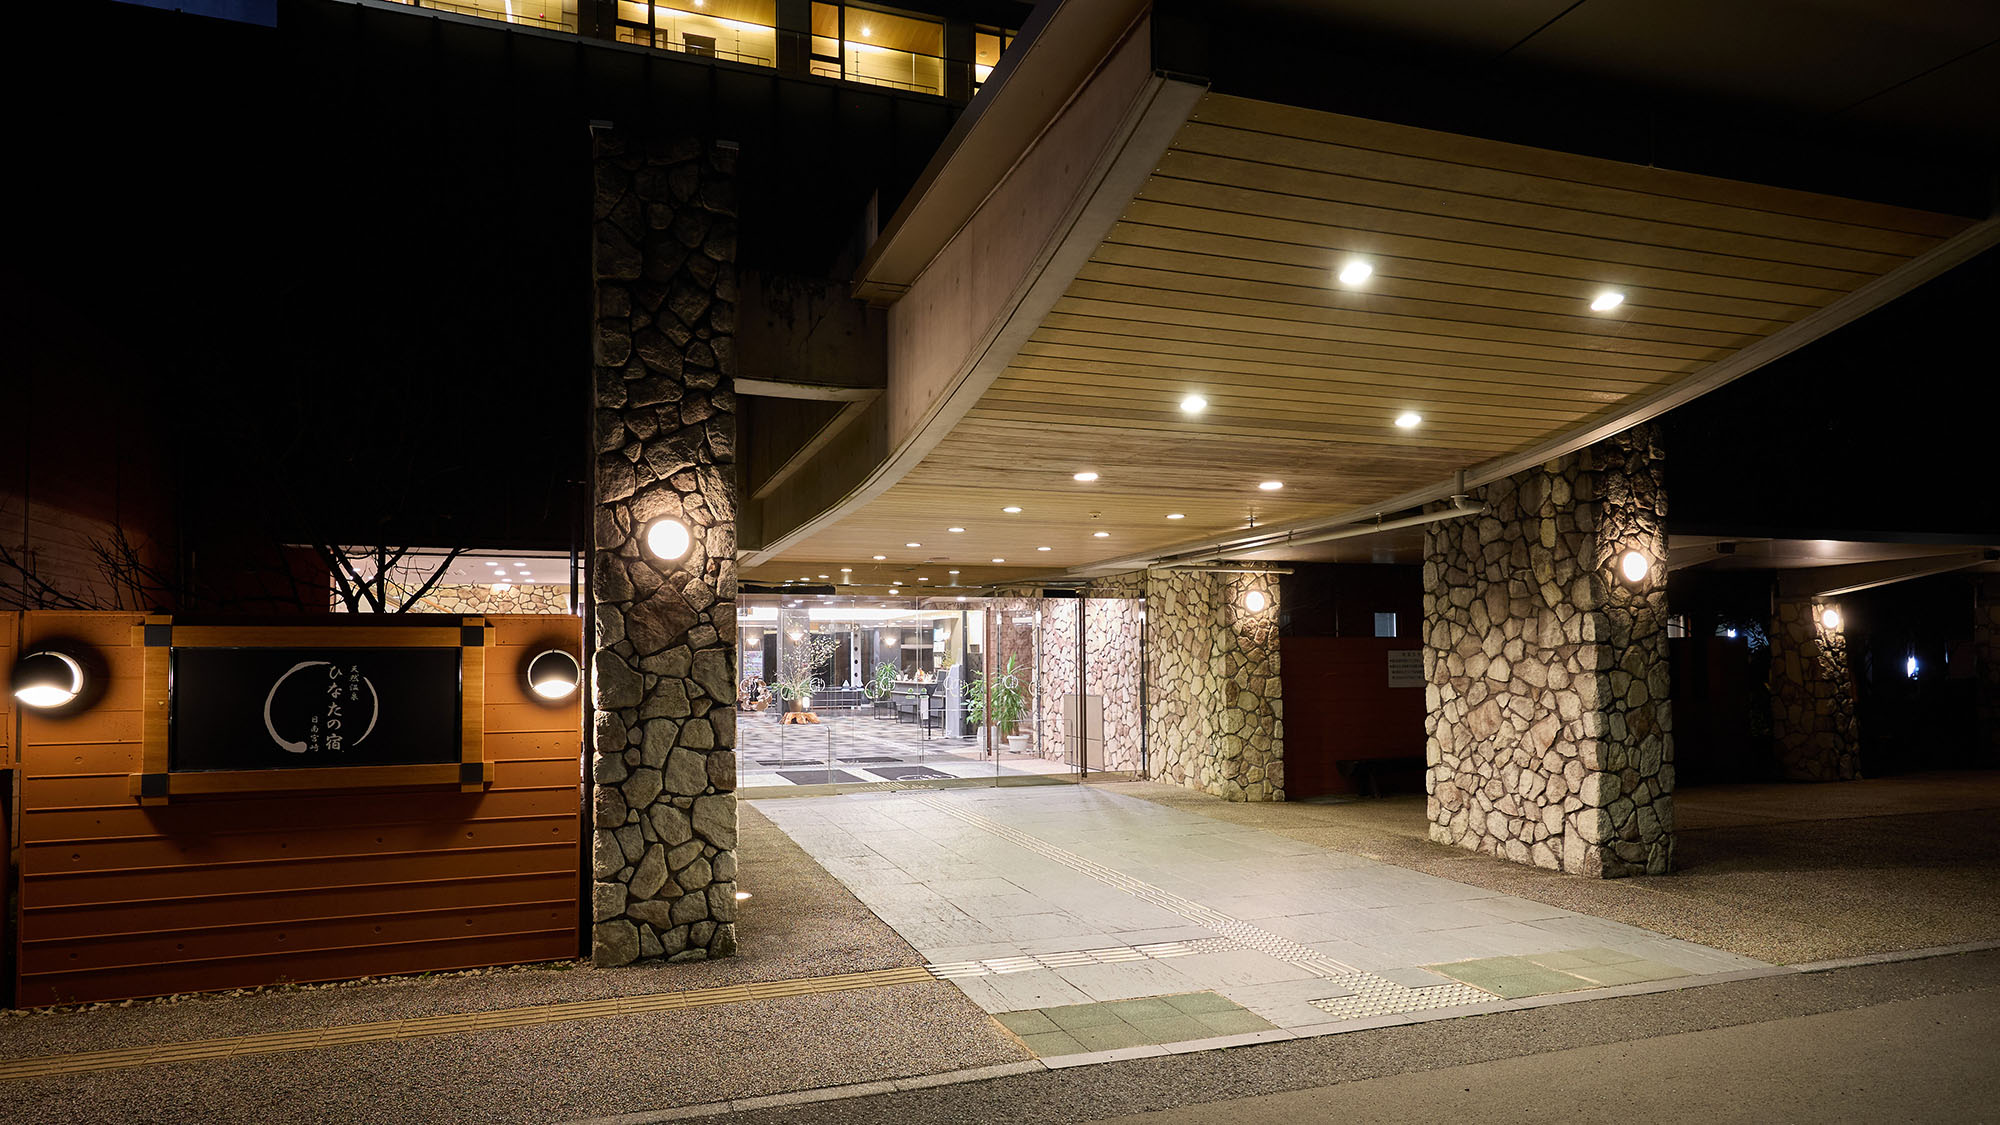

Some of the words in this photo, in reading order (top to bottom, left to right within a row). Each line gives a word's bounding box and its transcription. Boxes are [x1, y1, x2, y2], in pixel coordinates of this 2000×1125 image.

[348, 665, 360, 701] 天然温泉
[325, 665, 343, 751] ひなたの宿
[309, 715, 320, 752] 日南宮崎
